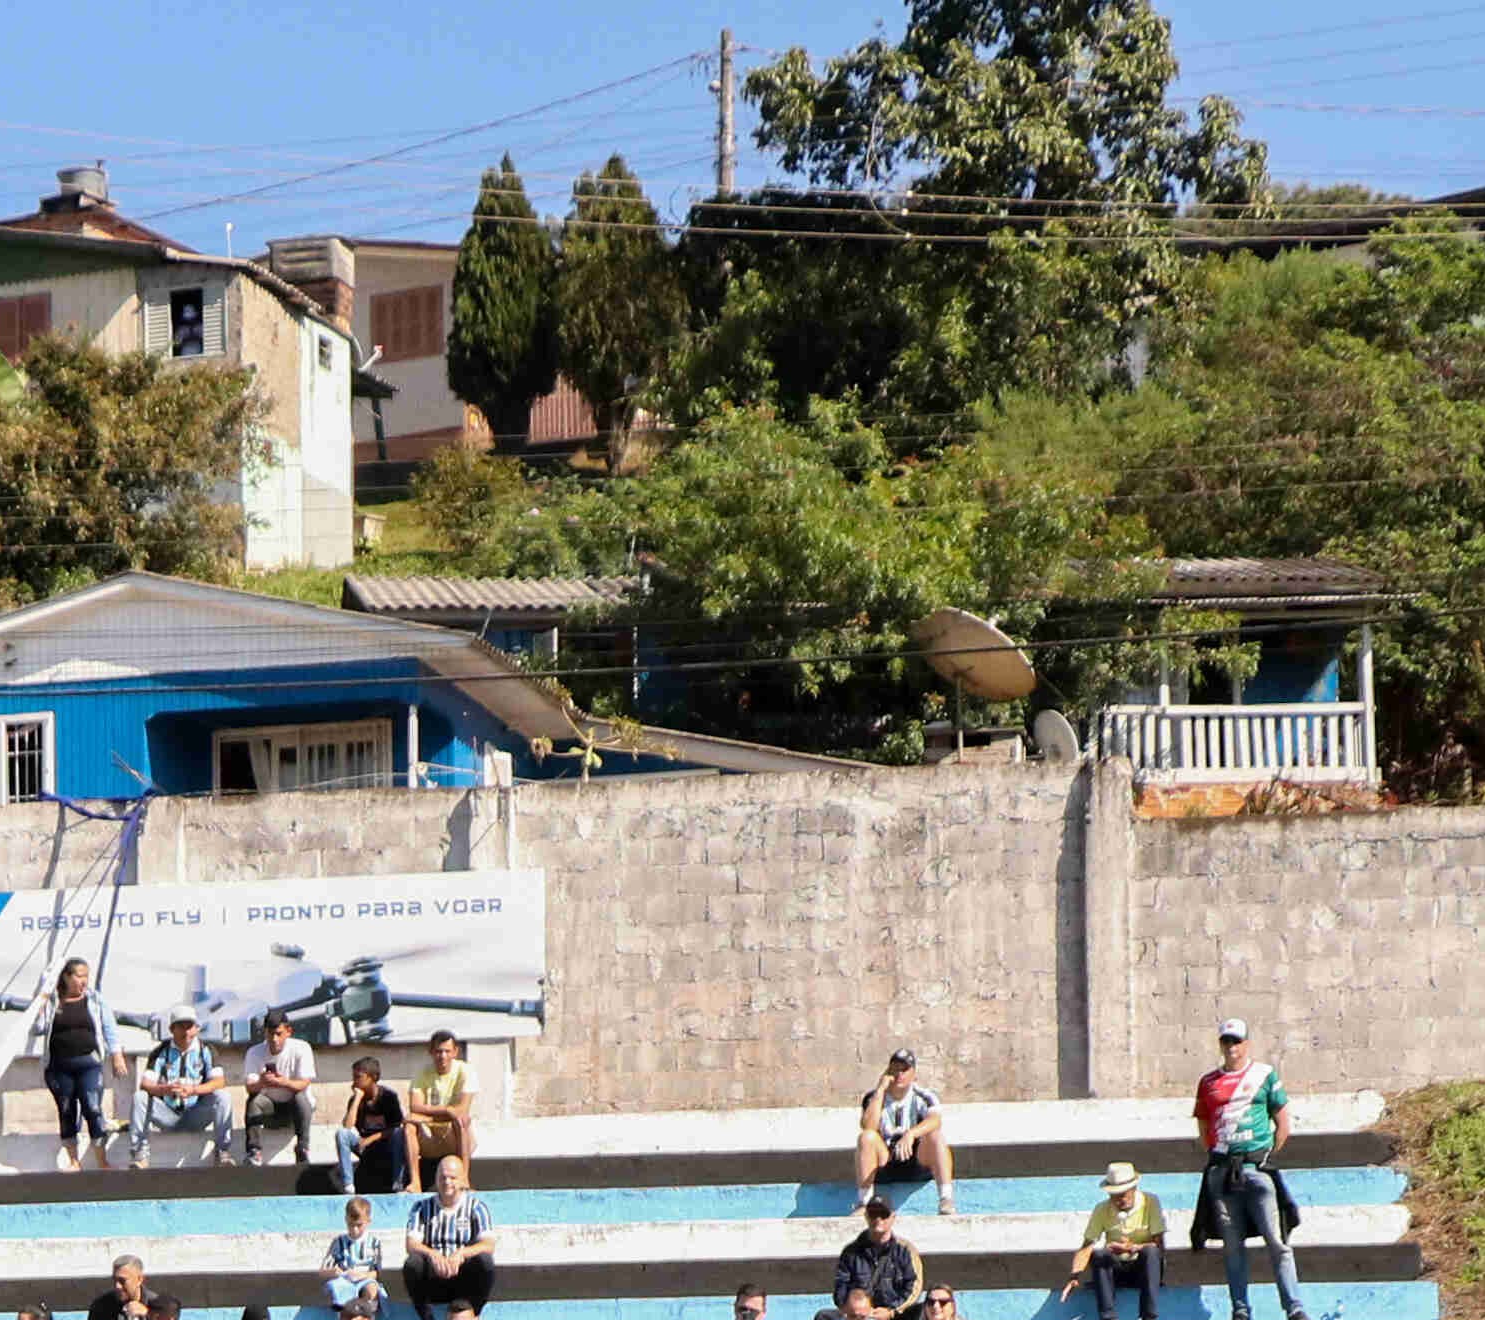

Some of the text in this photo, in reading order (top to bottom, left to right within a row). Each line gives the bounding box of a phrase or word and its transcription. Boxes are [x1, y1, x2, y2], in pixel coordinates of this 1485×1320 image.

[113, 909, 144, 927] TO
[157, 908, 202, 927] FLY
[247, 902, 346, 922] PRONTO
